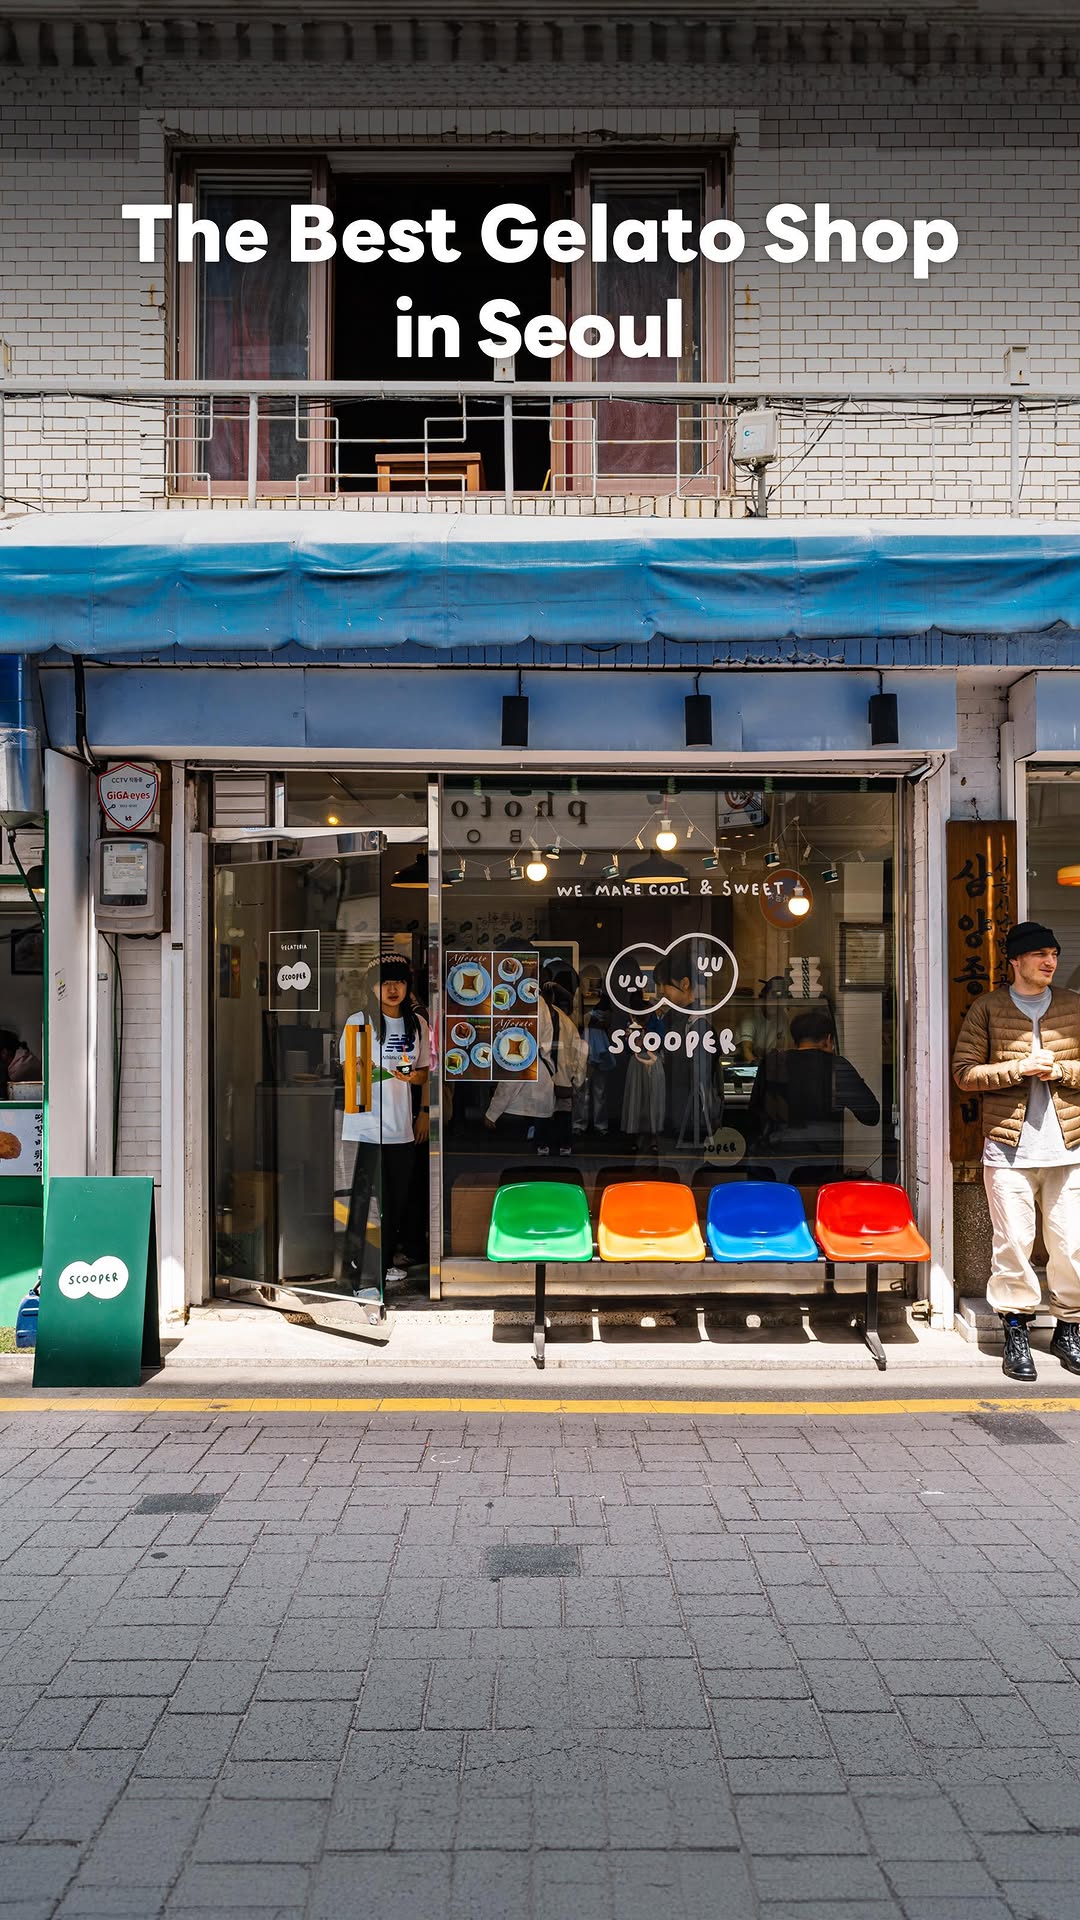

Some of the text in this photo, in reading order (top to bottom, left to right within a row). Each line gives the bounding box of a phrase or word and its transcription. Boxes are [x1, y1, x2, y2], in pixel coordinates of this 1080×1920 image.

[106, 791, 150, 801] GiGA eyes
[557, 879, 785, 898] WE MAKE COOL & SWEET
[281, 971, 307, 982] SCOOPER
[608, 1027, 737, 1058] SCOOPER
[68, 1271, 119, 1285] SCOOPER
